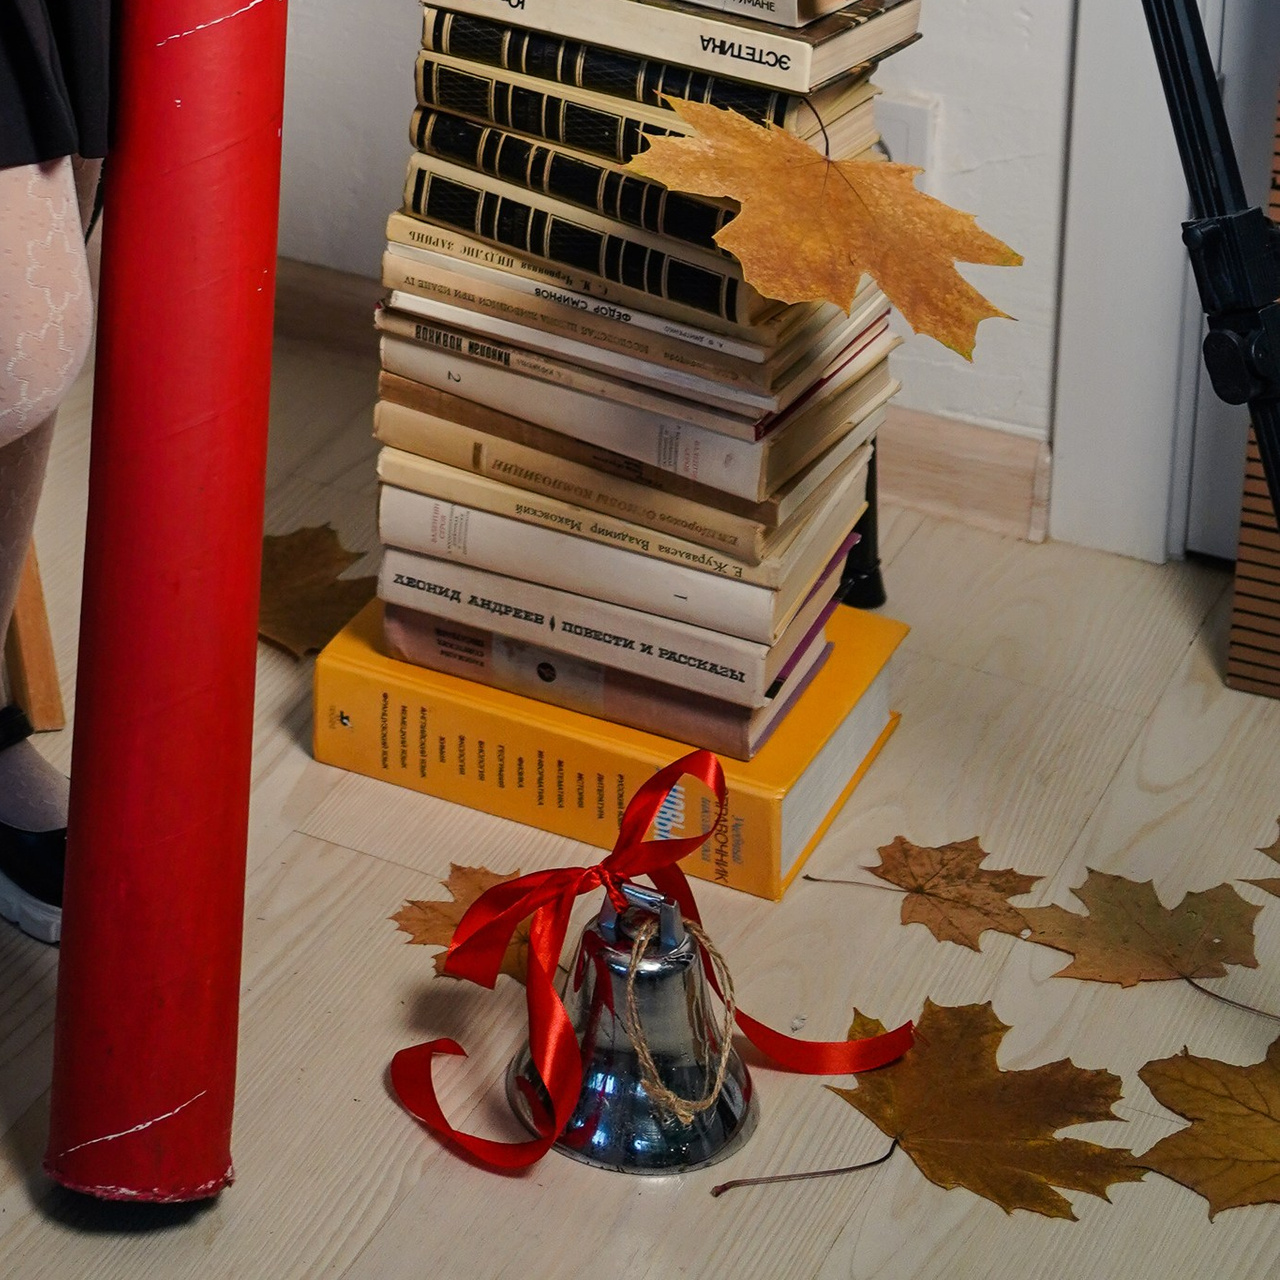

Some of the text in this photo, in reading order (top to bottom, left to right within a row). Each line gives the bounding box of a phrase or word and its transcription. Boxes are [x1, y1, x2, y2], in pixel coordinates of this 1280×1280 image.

[700, 34, 791, 71] ЭСТЕТИКА
[408, 230, 454, 250] ЗАРИНЬ
[459, 244, 514, 267] ИНДУЛИС
[533, 287, 588, 309] СМИРНОВ
[413, 324, 464, 351] НОВИКОВ
[446, 370, 462, 384] 2
[491, 457, 594, 500] КОМПОЗИЦИИ
[514, 503, 743, 577] Е. Журавлева Владимир Маковский
[392, 573, 747, 683] ЛЕОНИД АНДРЕЕВ ПОВЕСТИ И РАССКАЗЫ
[380, 691, 389, 770] ФРАНЦУЗСКИЙ ЯЗЫК
[399, 705, 408, 769] НЕМЕЦКИЙ ЯЗЫК
[419, 706, 428, 779] АНГЛИЙСКИЙ ЯЗЫК
[438, 736, 446, 764] ХИМИЯ
[477, 740, 485, 781] БИОЛОГИЯ
[497, 744, 505, 789] ГЕОГРАФИЯ
[654, 784, 686, 841] НОВЫ
